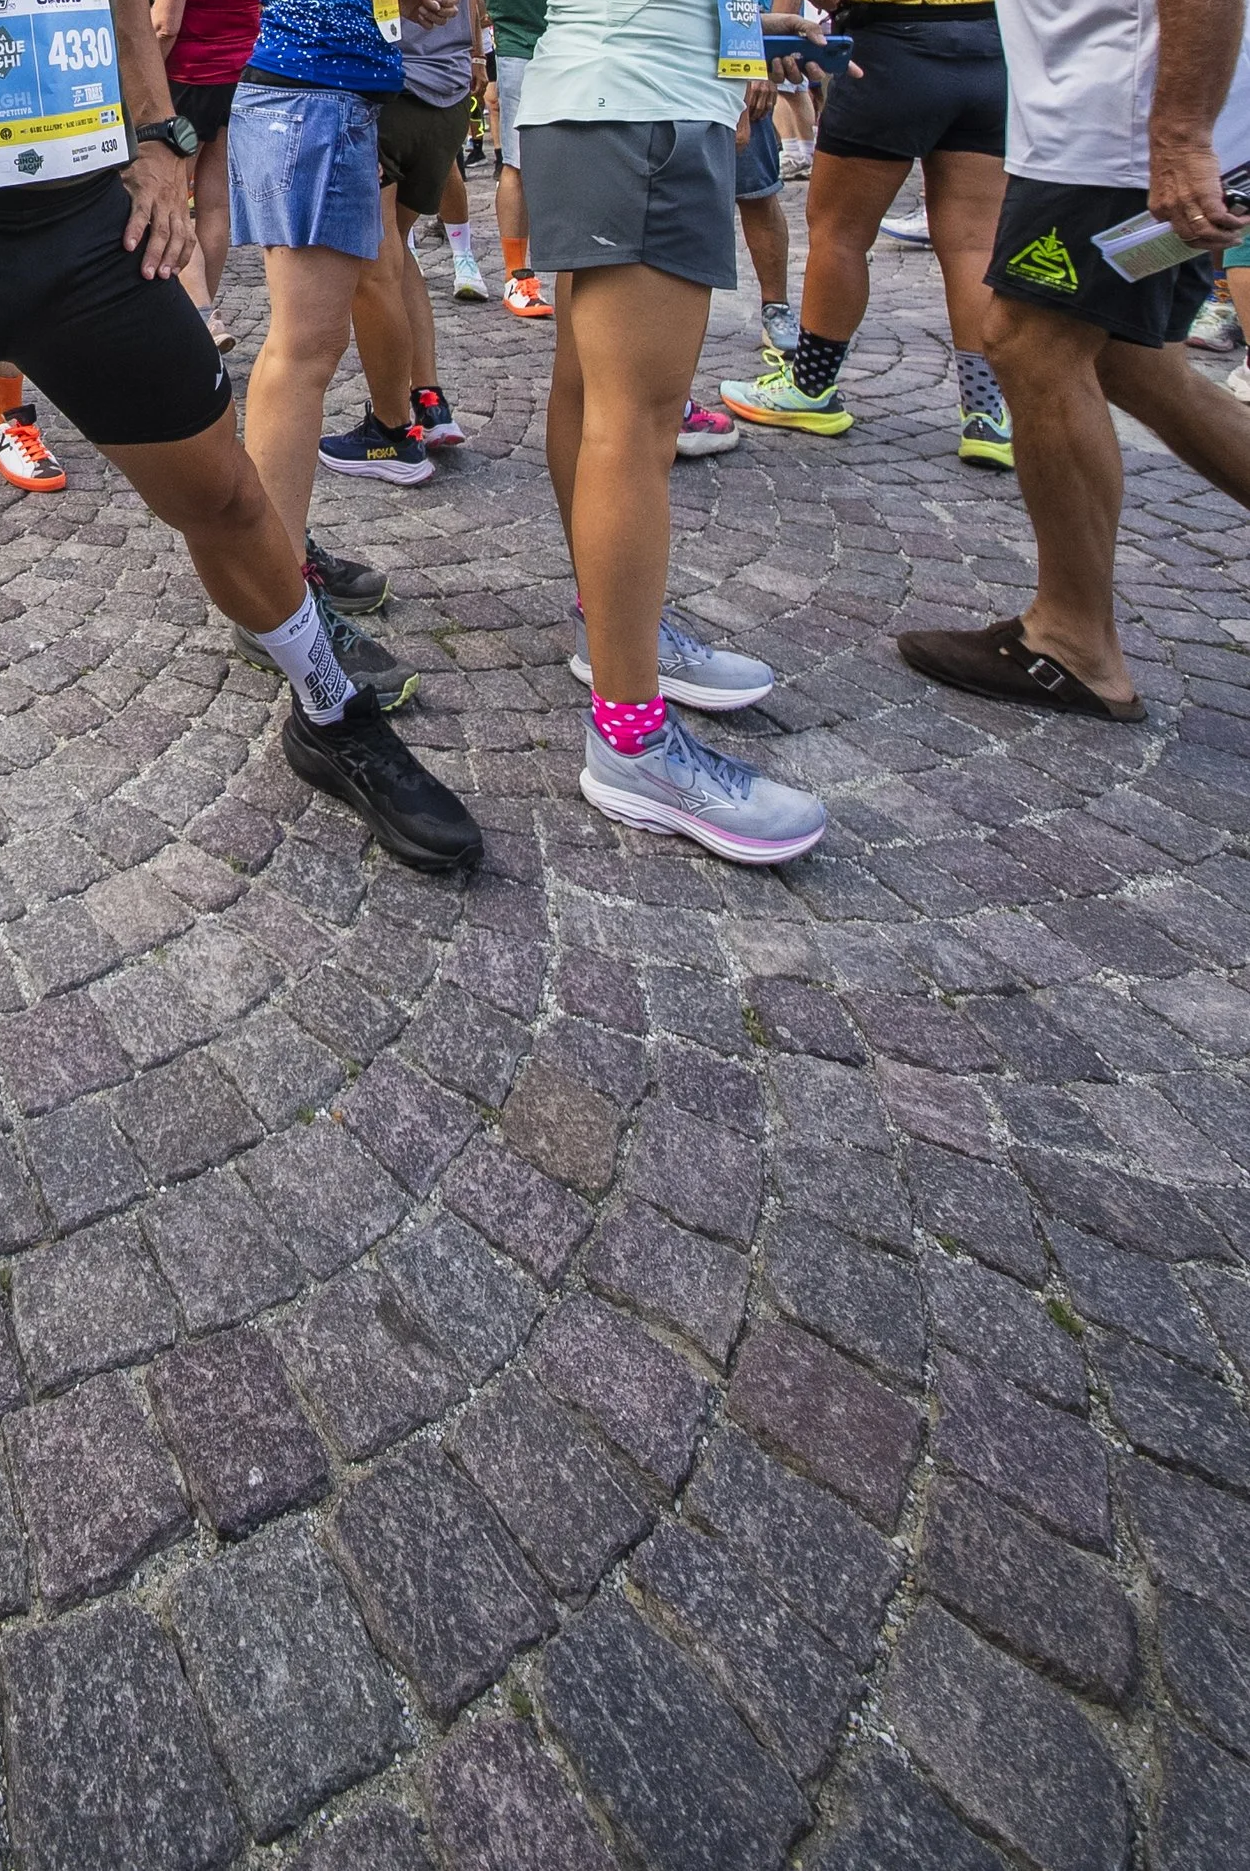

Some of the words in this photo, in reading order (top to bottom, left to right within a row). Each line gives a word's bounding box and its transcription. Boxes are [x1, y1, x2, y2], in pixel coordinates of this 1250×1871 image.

[725, 1, 758, 13] CINQUE
[48, 27, 113, 72] 4330
[101, 138, 118, 153] 4330
[366, 446, 398, 460] HOKA
